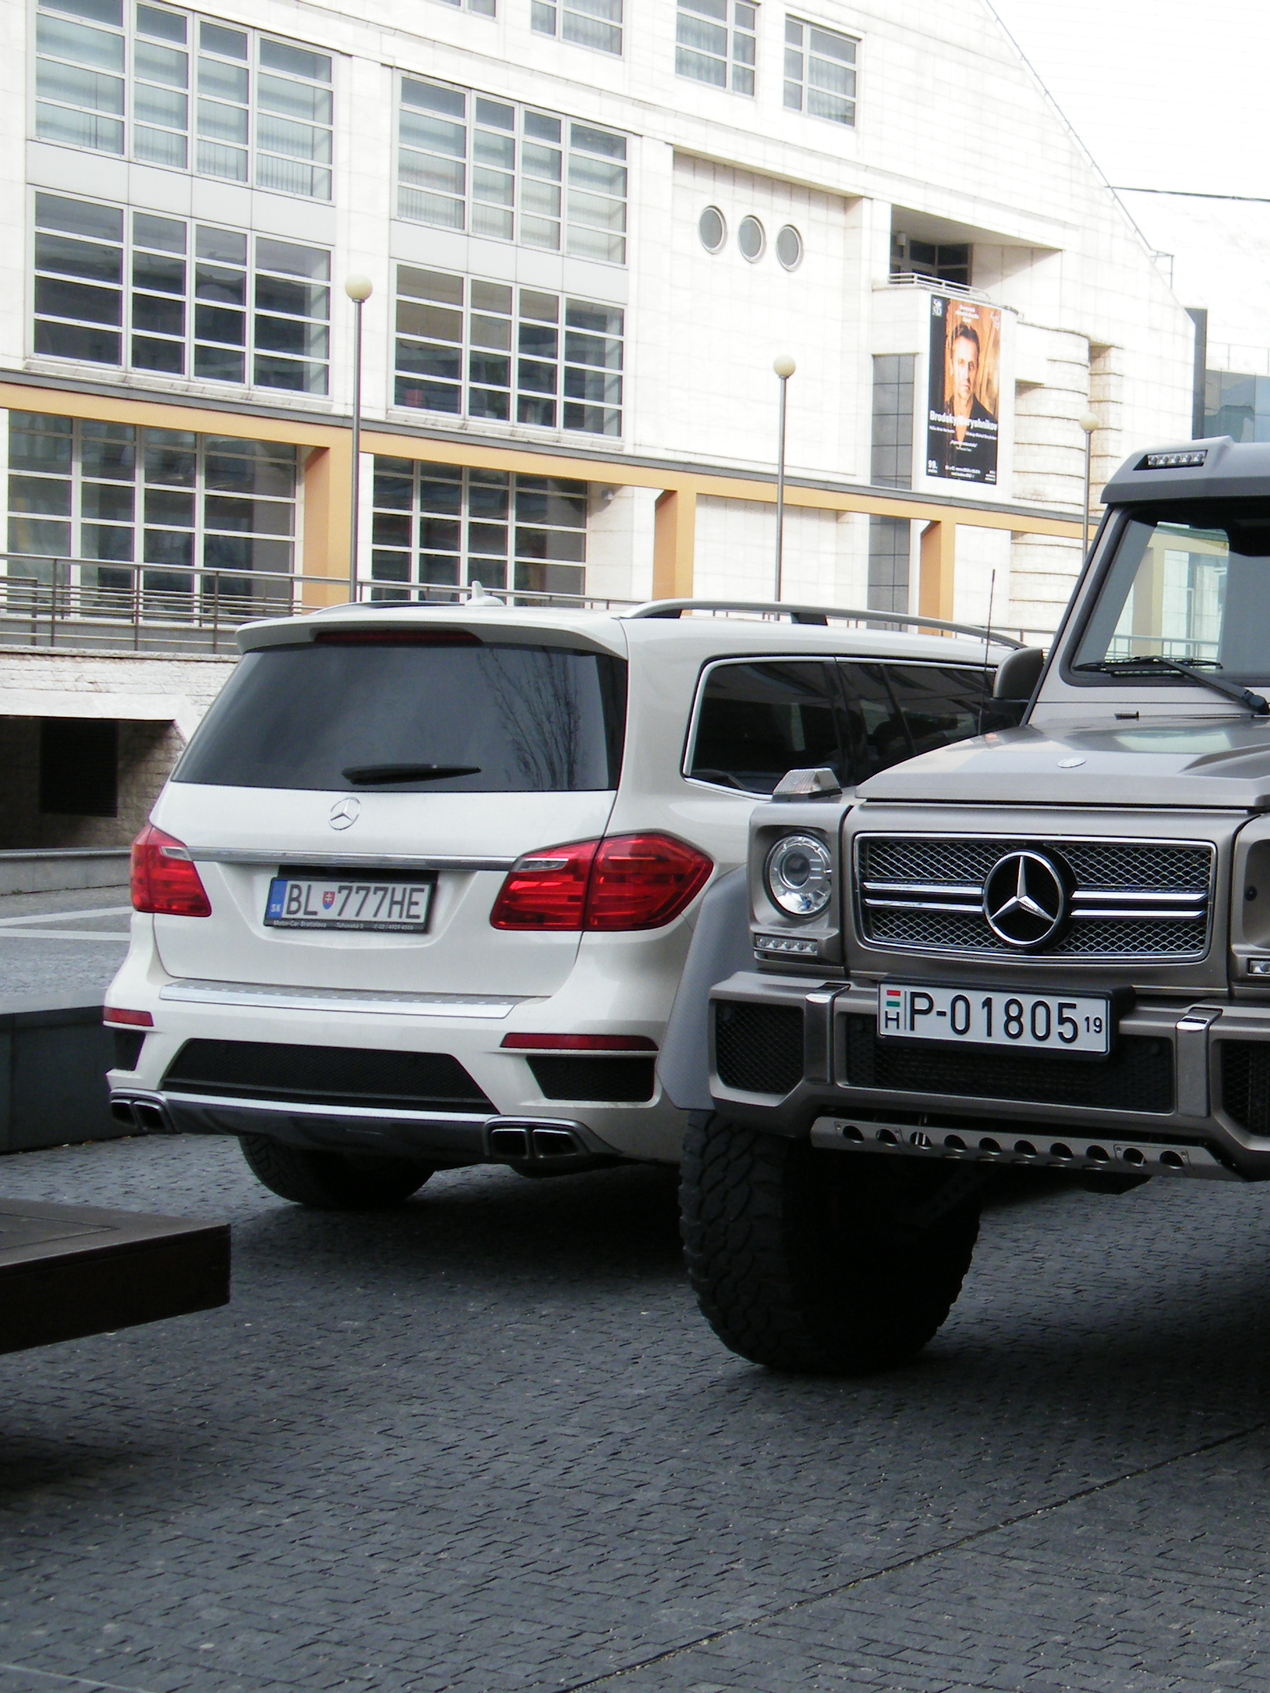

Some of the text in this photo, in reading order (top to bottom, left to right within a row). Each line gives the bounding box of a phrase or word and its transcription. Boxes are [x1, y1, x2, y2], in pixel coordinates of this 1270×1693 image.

[270, 903, 282, 913] SK
[285, 883, 426, 920] BL 777HE
[884, 1010, 900, 1030] H
[909, 991, 1103, 1044] P-01805 19
